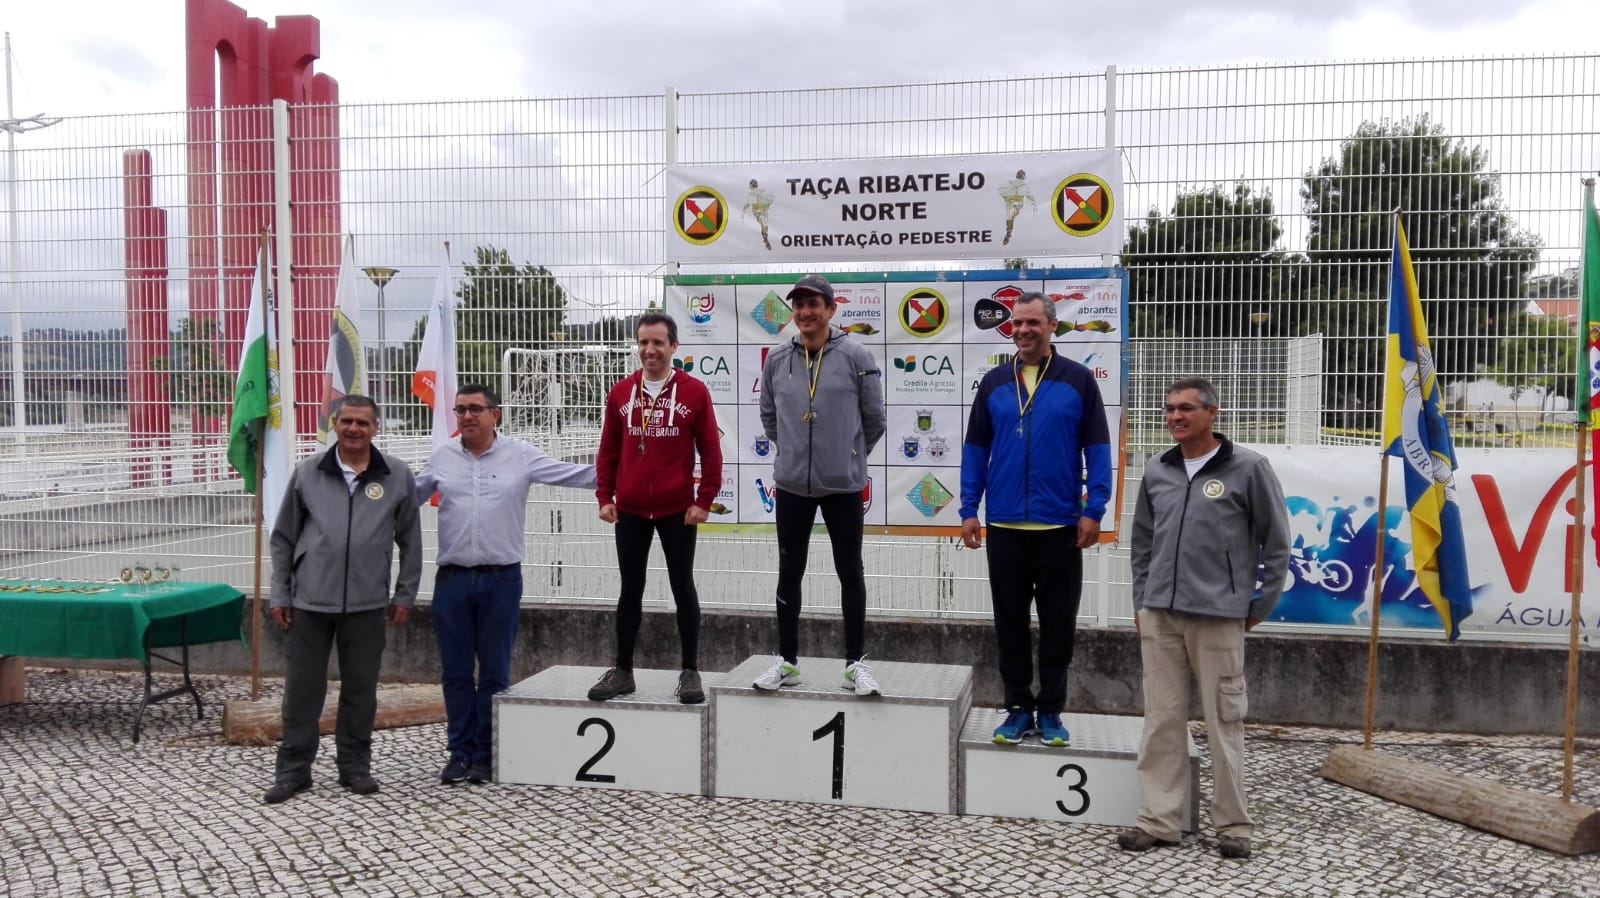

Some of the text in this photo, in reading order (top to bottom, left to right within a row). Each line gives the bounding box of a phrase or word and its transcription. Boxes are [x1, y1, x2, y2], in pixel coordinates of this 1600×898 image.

[786, 171, 985, 200] TAÇA RIBATEJO
[841, 202, 927, 222] NORTE
[780, 230, 992, 249] ORIENTAÇÃO PEDESTRE
[841, 309, 881, 318] abrantes
[1077, 305, 1118, 315] abrantes
[700, 355, 730, 376] CA
[922, 355, 955, 376] CA
[656, 397, 692, 419] STOAGE
[655, 427, 680, 437] BRAND
[575, 717, 617, 784] 2
[812, 711, 846, 801] 1
[1055, 763, 1091, 817] 3
